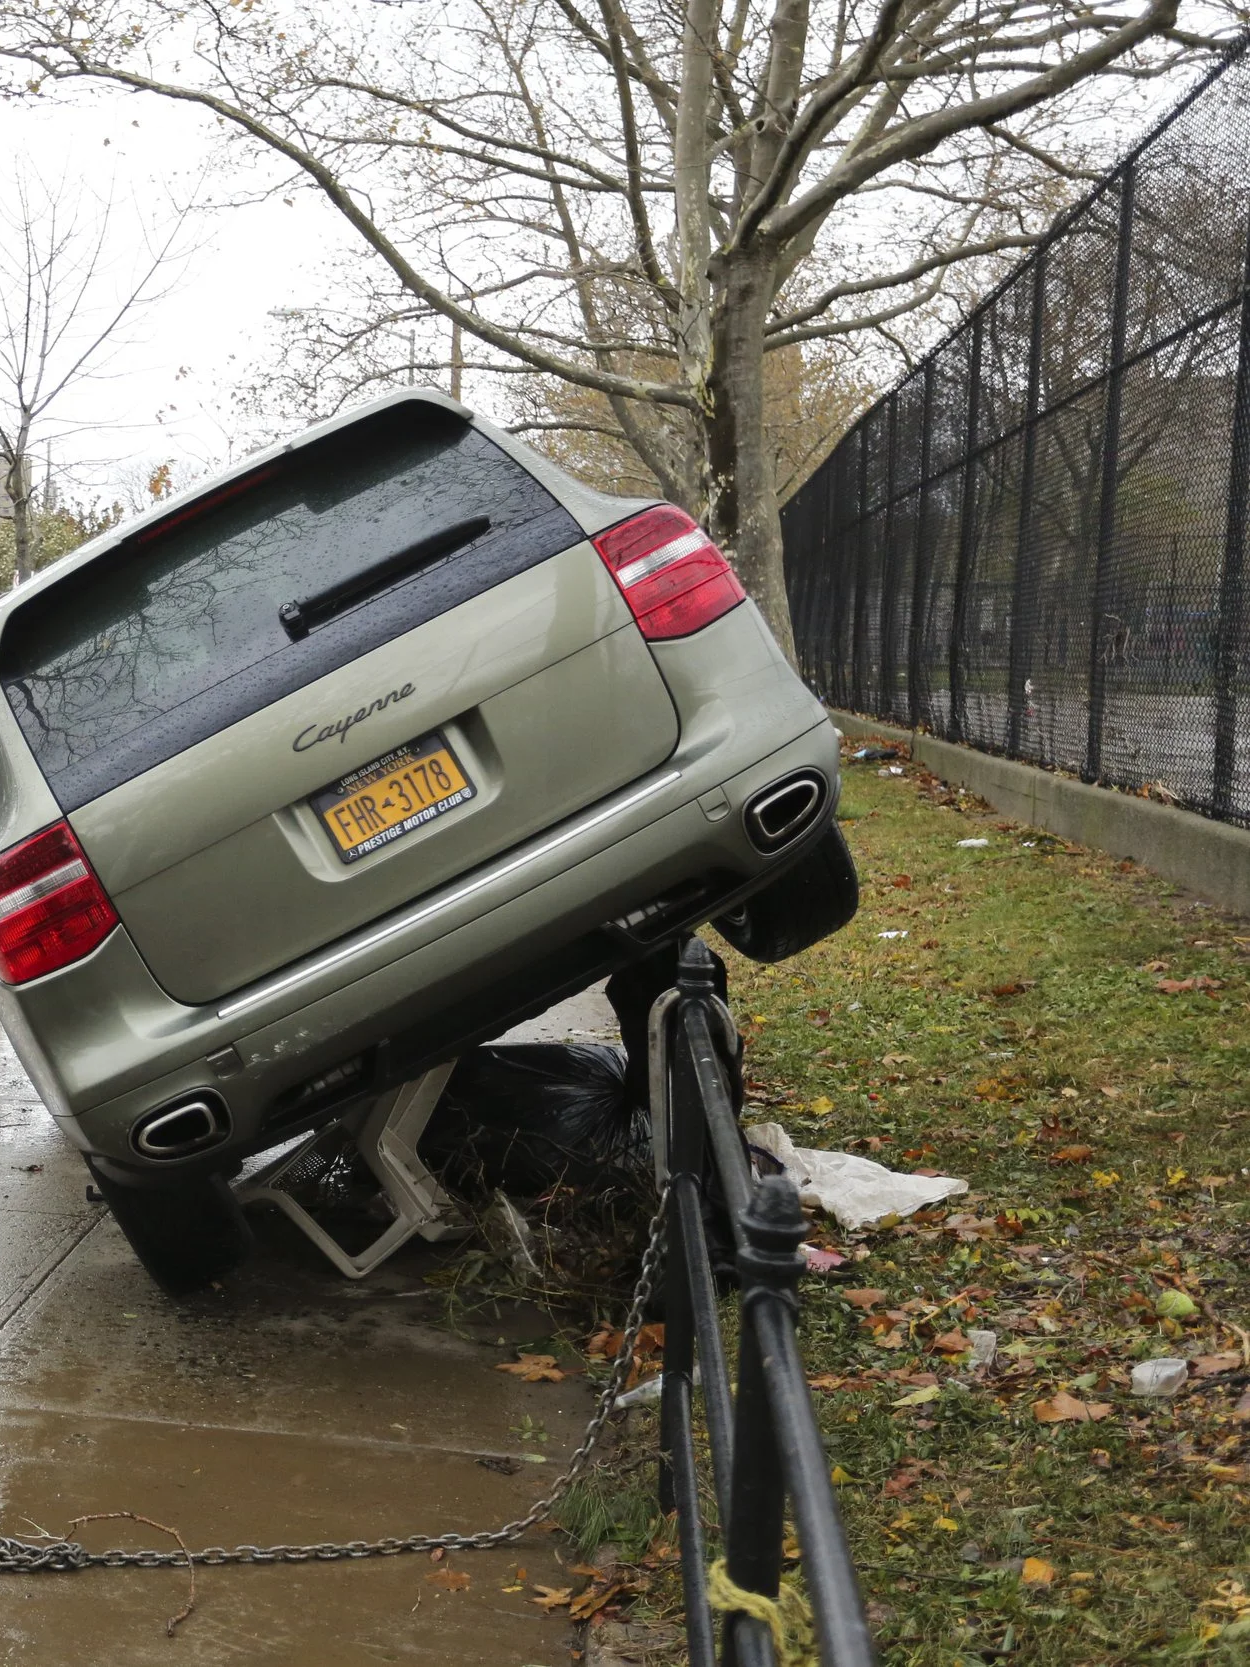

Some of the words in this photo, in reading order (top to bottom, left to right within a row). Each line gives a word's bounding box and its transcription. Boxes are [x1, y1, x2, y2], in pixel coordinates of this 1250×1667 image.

[292, 682, 417, 752] Cayenne
[340, 773, 358, 787] LONG
[358, 761, 381, 777] ISLAND
[345, 770, 379, 795] NEW
[379, 753, 415, 775] YORK
[357, 825, 403, 855] PRESTIGE
[403, 805, 438, 831] MOTOR
[437, 792, 463, 812] CLUB
